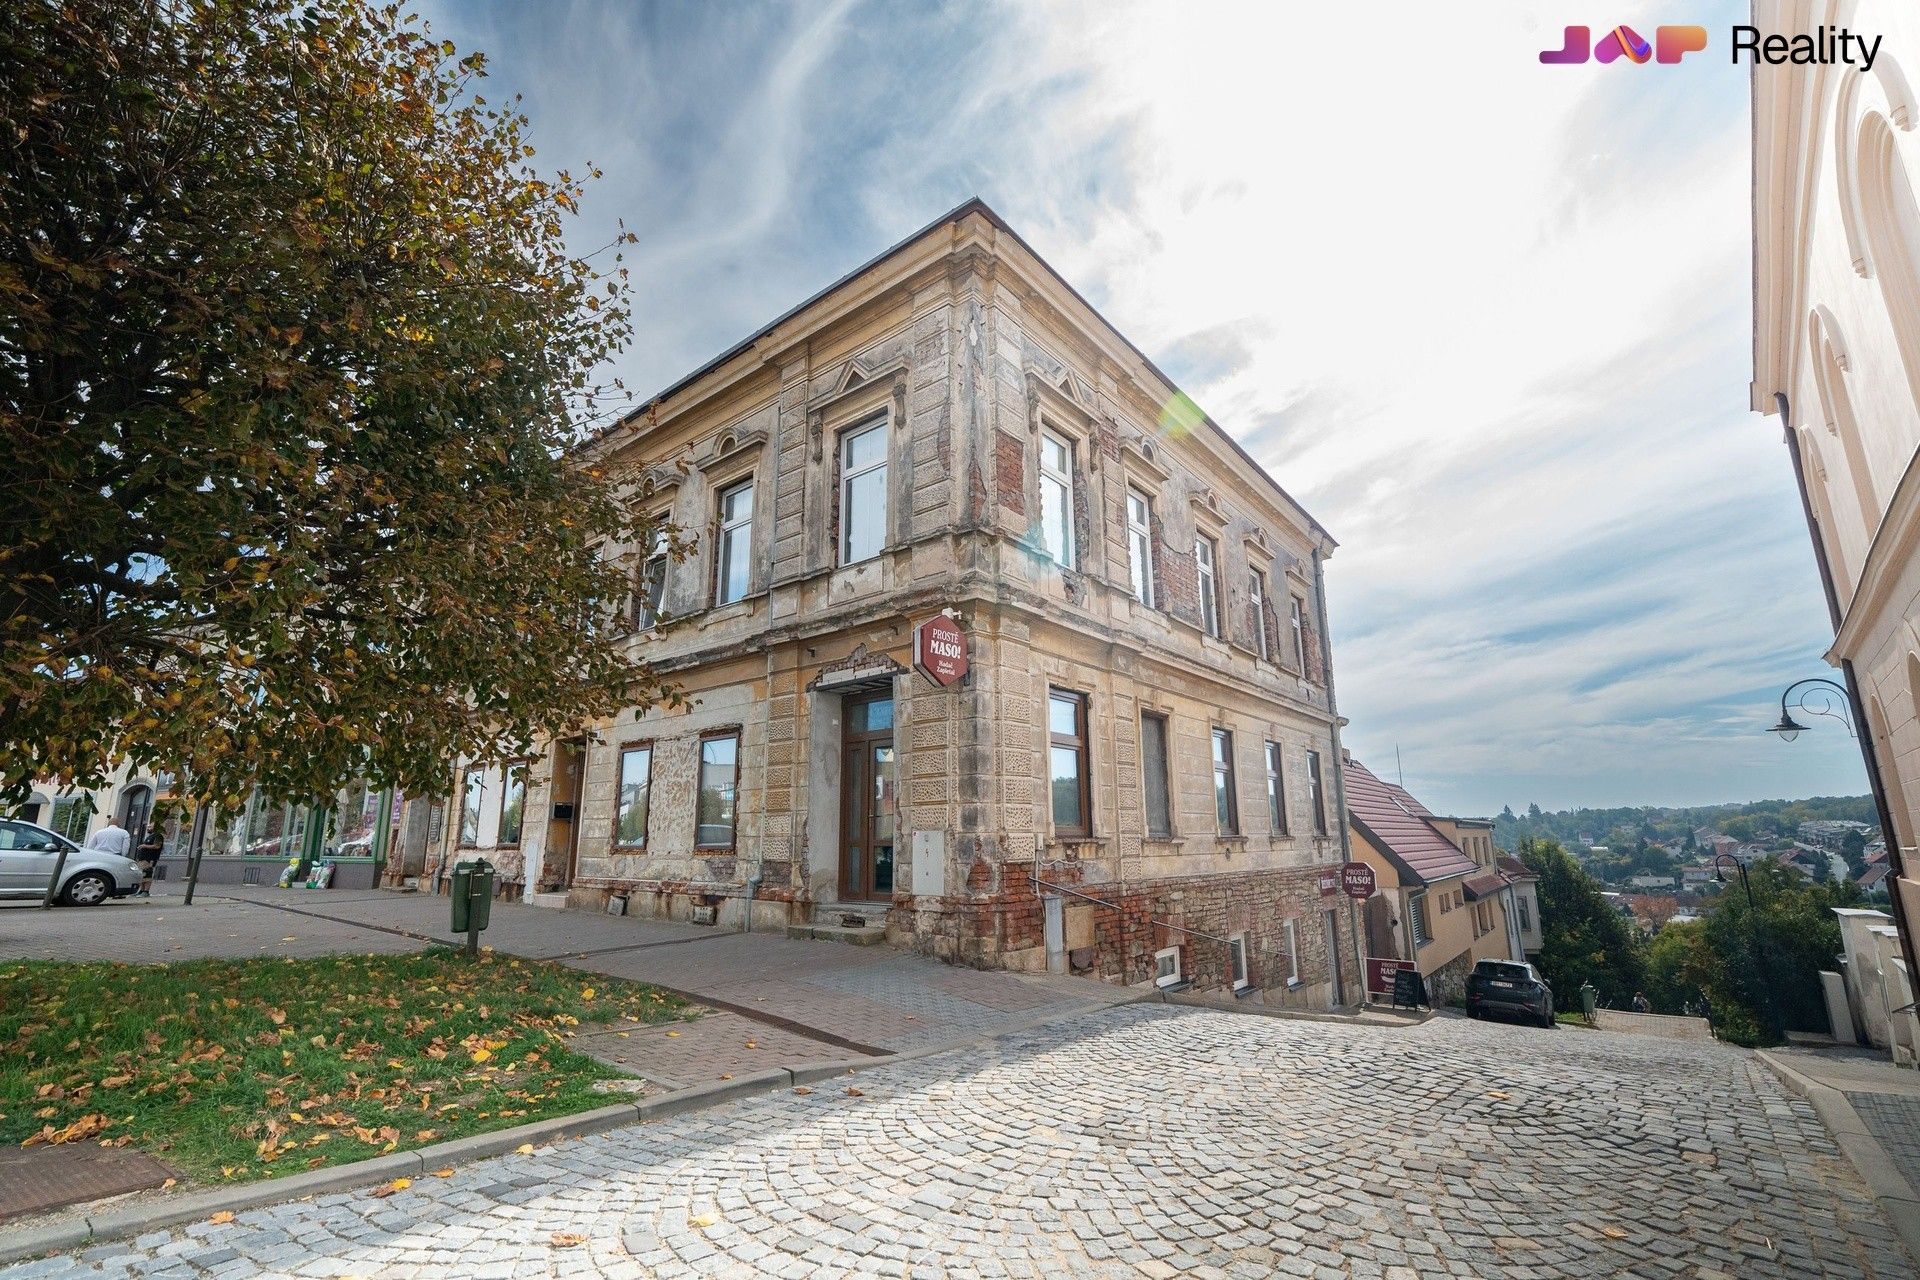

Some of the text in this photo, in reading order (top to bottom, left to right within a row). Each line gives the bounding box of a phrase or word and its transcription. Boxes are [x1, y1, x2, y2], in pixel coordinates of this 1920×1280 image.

[932, 628, 959, 644] PROSTÉ
[930, 640, 961, 659] MASO!
[1346, 868, 1369, 876] PROSTÉ
[1345, 875, 1371, 885] MASO!
